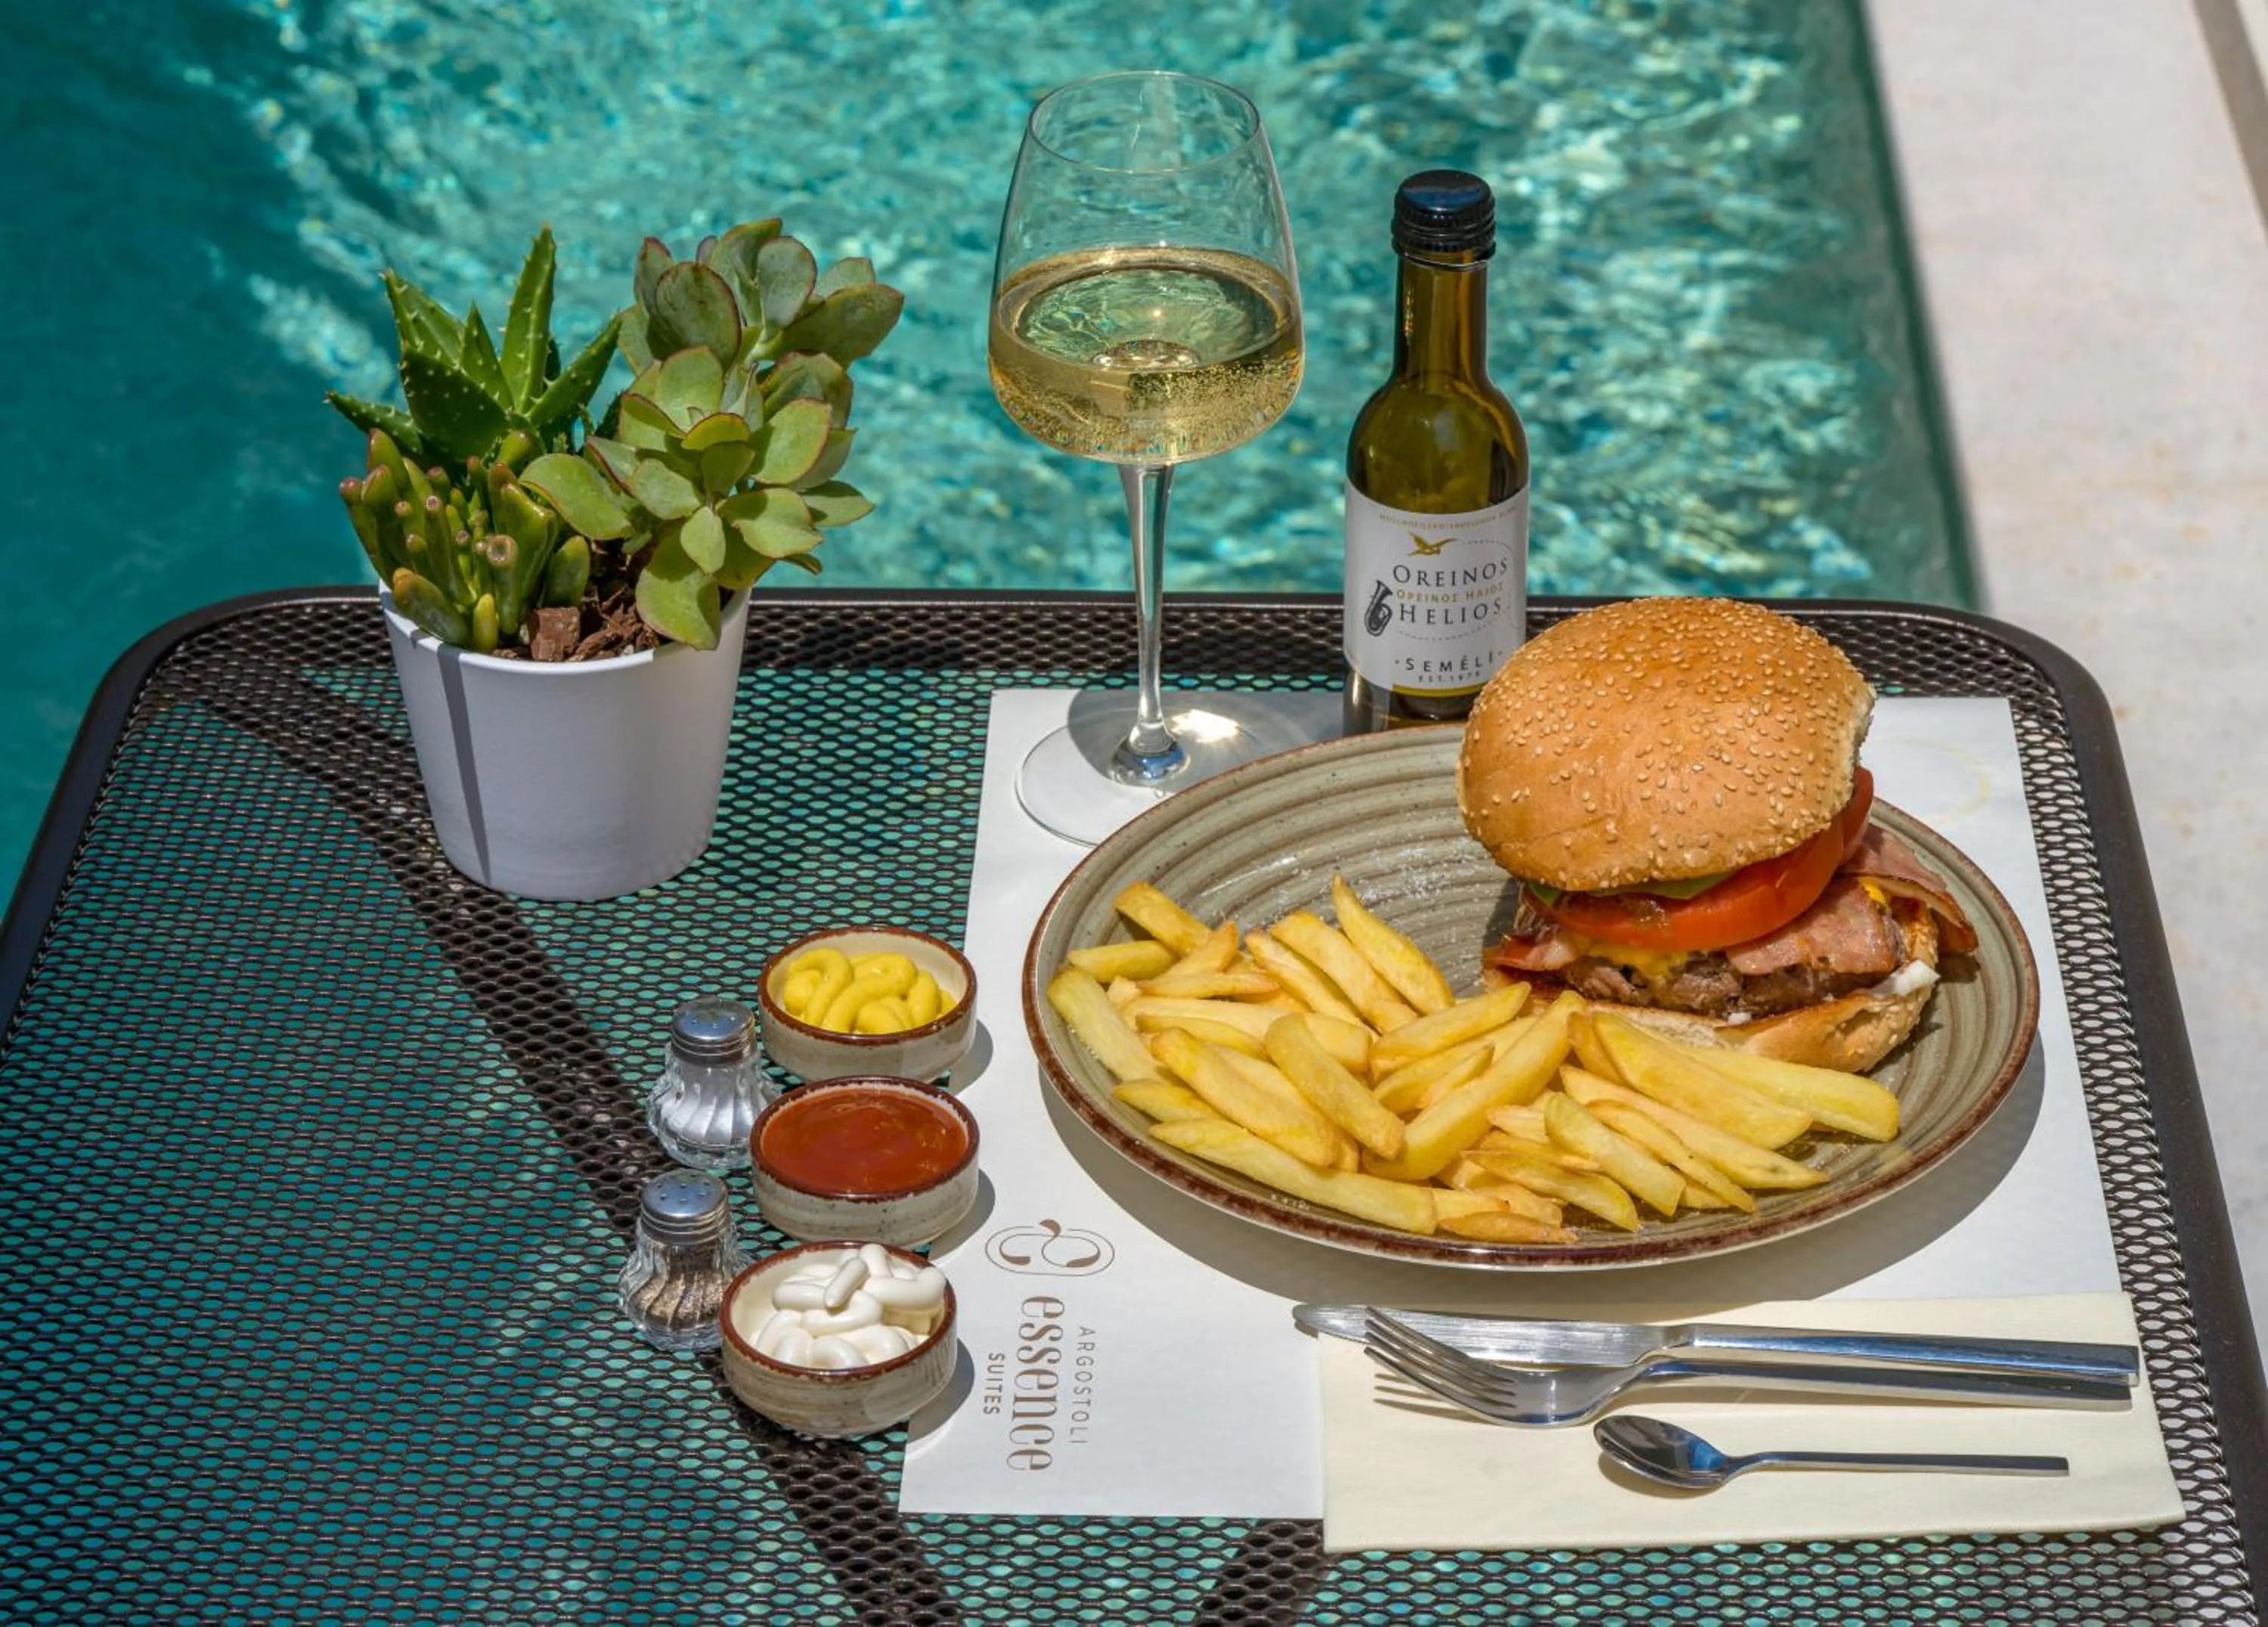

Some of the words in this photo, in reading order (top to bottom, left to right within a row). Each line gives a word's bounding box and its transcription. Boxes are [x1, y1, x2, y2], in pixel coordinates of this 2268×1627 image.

[1393, 557, 1508, 587] OREINOS
[1399, 597, 1501, 625] HELIOS
[983, 1353, 1005, 1415] SUITES
[1006, 1296, 1065, 1470] essence
[1070, 1326, 1096, 1444] ARGOSTOLI
